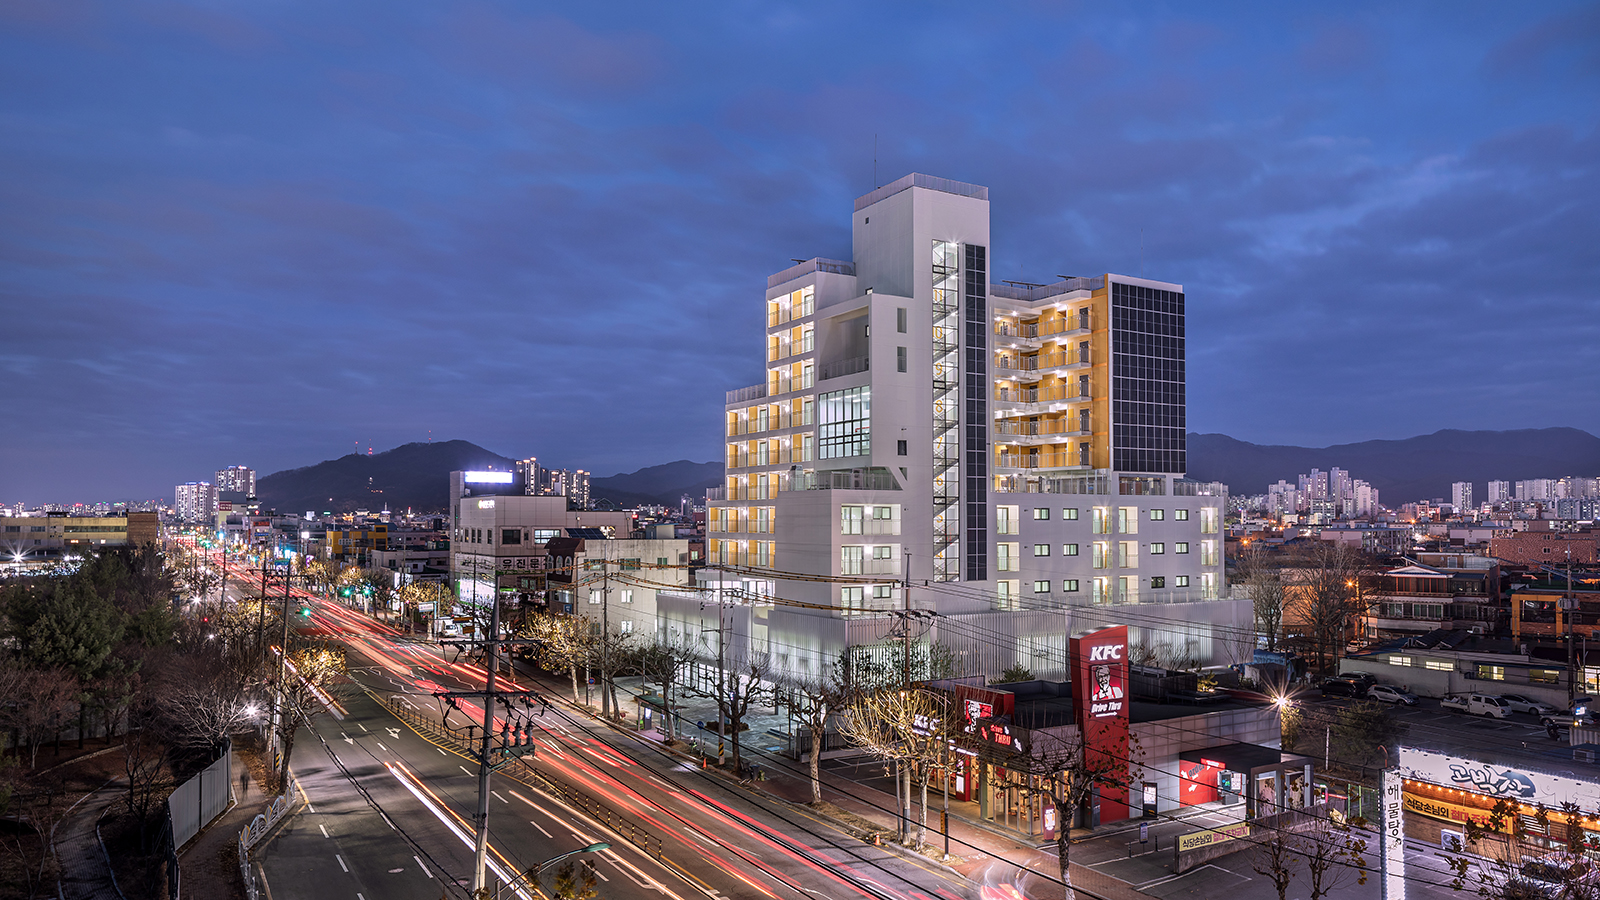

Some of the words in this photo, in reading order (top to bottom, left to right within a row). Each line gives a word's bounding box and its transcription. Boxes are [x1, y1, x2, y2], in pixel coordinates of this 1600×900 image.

[934, 289, 943, 302] 11
[932, 326, 943, 339] 10
[935, 363, 943, 375] 9
[935, 400, 943, 413] 8
[937, 436, 943, 449] 7
[936, 473, 944, 486] 6
[1089, 644, 1124, 661] KFC
[1091, 703, 1108, 713] Drive
[1108, 701, 1122, 711] Thru
[913, 714, 941, 731] KFC
[994, 732, 1011, 746] THRU
[1387, 784, 1400, 836] 해물탕
[1407, 798, 1449, 818] 식당손님외
[1471, 813, 1508, 830] 주차
[1182, 834, 1213, 848] 식당손님외
